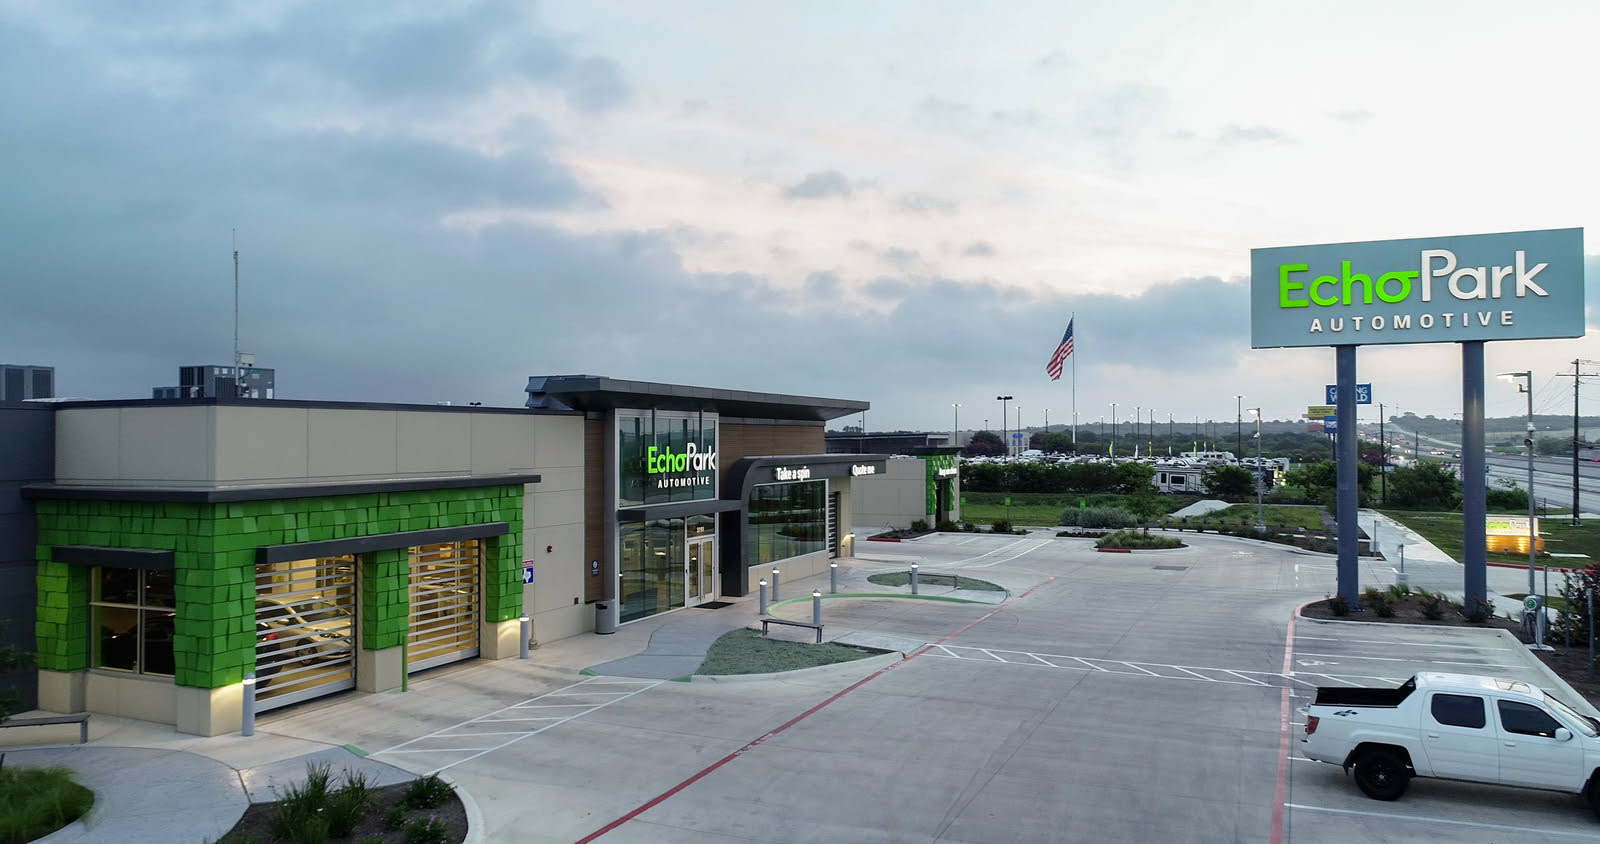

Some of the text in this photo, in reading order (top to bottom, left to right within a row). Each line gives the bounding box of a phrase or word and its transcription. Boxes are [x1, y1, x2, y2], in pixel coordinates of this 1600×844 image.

[1279, 249, 1550, 309] EchoPark
[1309, 310, 1515, 333] AUTOMOTIVE
[648, 442, 716, 474] EchoPark
[776, 465, 811, 482] Take a spin
[852, 464, 867, 477] Quote
[657, 476, 710, 489] AUTOMOTIVE
